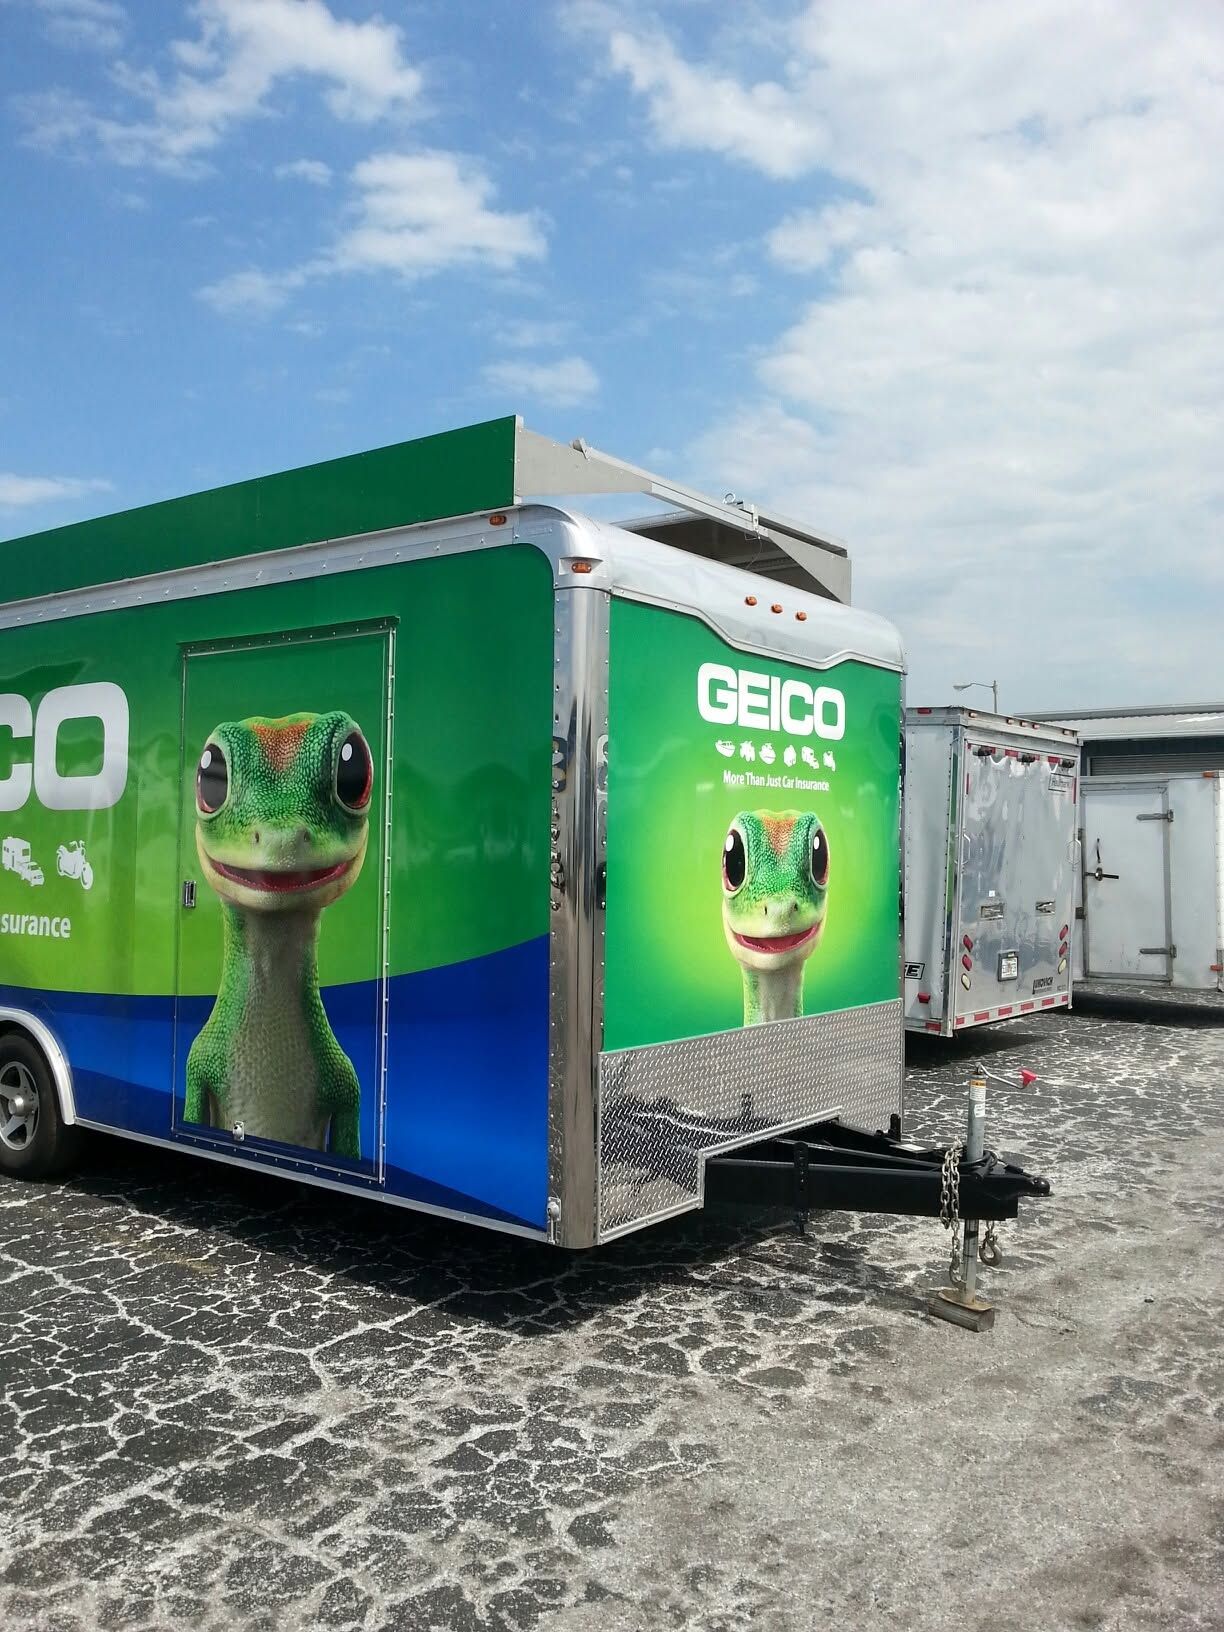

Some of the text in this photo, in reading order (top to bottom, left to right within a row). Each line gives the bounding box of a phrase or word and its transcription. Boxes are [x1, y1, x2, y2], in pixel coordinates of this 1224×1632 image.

[697, 662, 846, 741] GEICO
[723, 770, 830, 792] More Than Just Car Insurance
[0, 913, 72, 938] surance
